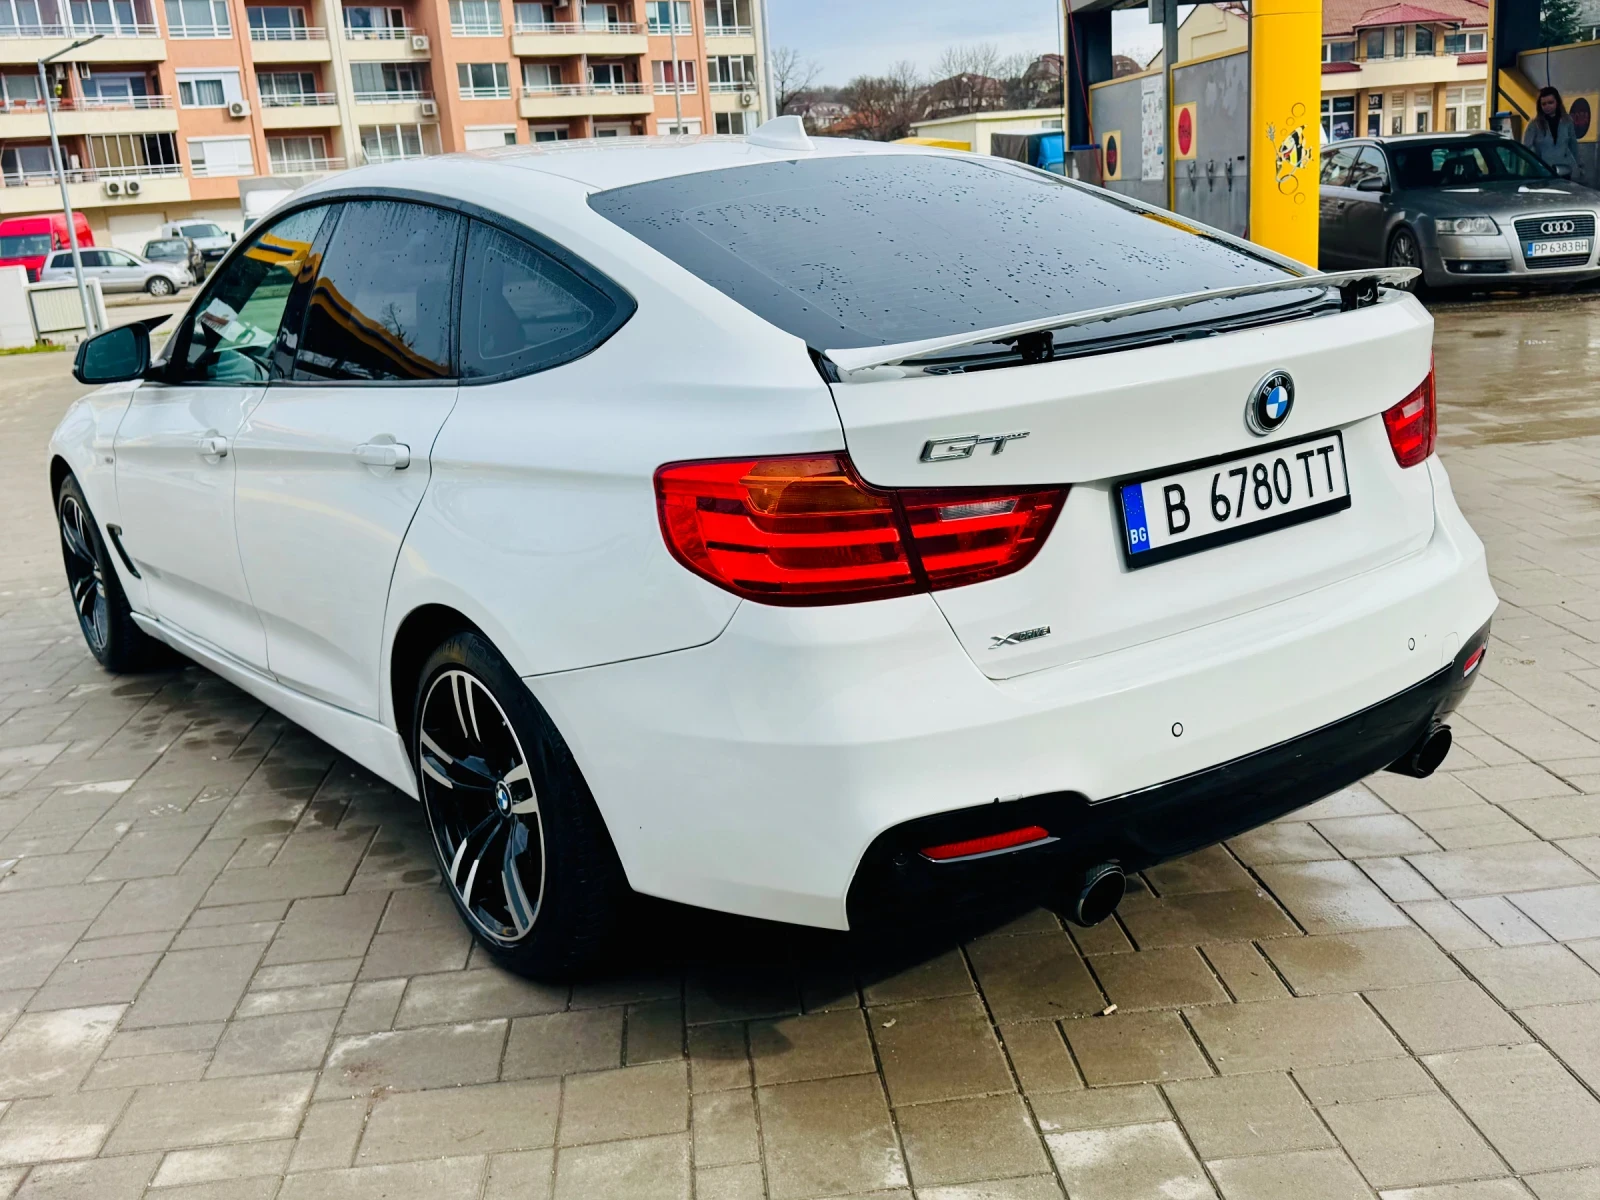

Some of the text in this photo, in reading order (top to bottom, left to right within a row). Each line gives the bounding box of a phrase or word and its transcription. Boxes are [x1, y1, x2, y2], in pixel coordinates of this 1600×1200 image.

[1534, 241, 1587, 254] PP 6383 BH
[1263, 377, 1291, 397] BMW
[919, 431, 1031, 462] GT
[1163, 444, 1335, 536] B 6780 TT
[1130, 526, 1147, 545] BG
